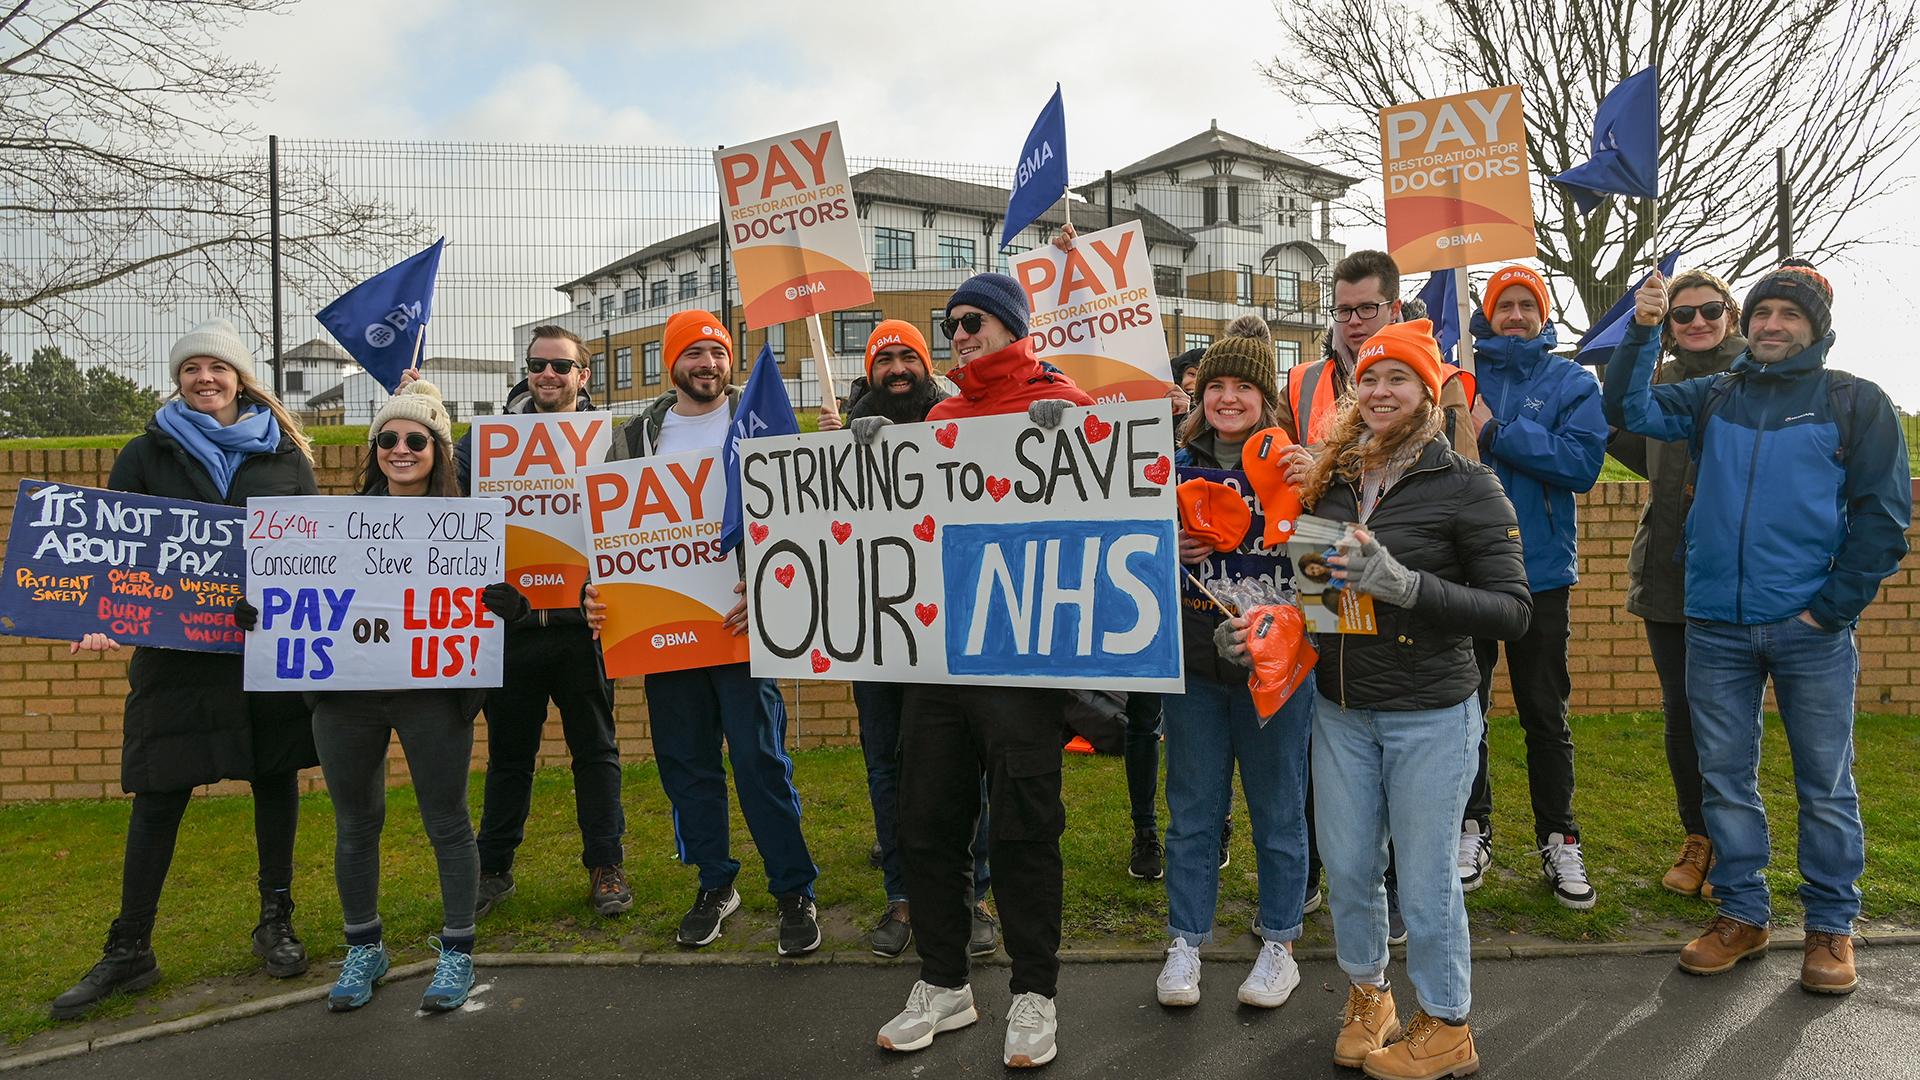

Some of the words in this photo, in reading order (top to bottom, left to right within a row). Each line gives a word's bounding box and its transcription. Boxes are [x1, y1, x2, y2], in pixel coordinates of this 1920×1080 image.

[1386, 93, 1513, 160] PAY
[721, 131, 832, 207] PAY
[1018, 140, 1053, 188] BMA
[1390, 147, 1486, 172] RESTORATION
[1489, 142, 1518, 156] FOR
[1390, 156, 1520, 194] DOCTORS
[731, 191, 817, 220] RESTORATION
[820, 184, 845, 200] FOR
[734, 198, 848, 244] DOCTORS
[1451, 232, 1482, 246] BMA
[1016, 230, 1135, 312] PAY
[1514, 271, 1536, 284] BMA
[798, 281, 826, 297] BMA
[1029, 295, 1118, 328] RESTORATION
[1120, 287, 1148, 304] FOR
[714, 328, 729, 344] BMA
[877, 334, 901, 347] BMA
[1030, 303, 1152, 353] DOCTORS
[1361, 344, 1385, 358] BMA
[1097, 392, 1128, 405] BMA
[479, 420, 603, 477] PAY
[744, 440, 924, 519] STRIKING
[1014, 417, 1162, 506] SAVE
[479, 478, 574, 492] RESTORATION
[586, 457, 714, 534] PAY
[96, 499, 162, 536] NOT
[168, 508, 247, 550] JUST
[427, 512, 494, 540] YOUR
[594, 526, 693, 550] RESTORATION
[696, 522, 723, 537] FOR
[33, 530, 147, 568] ABOUT
[251, 546, 337, 576] Conscience
[365, 547, 413, 575] Steve
[596, 539, 729, 578] DOCTORS
[16, 567, 94, 590] PATIENT
[108, 569, 154, 584] OVER
[112, 582, 173, 600] WORKED
[180, 578, 242, 594] UNSAFE
[534, 574, 564, 586] BMA
[32, 589, 88, 606] SAFETY
[262, 587, 356, 632] PAY
[404, 587, 494, 630] LOSE
[754, 536, 917, 667] OUR
[965, 533, 1160, 656] NHS
[110, 619, 152, 635] OUT
[179, 612, 239, 629] UNDER
[184, 628, 244, 642] VALUED
[353, 618, 390, 644] OR
[666, 631, 698, 646] BMA
[277, 637, 334, 679] US
[411, 635, 480, 678] US!
